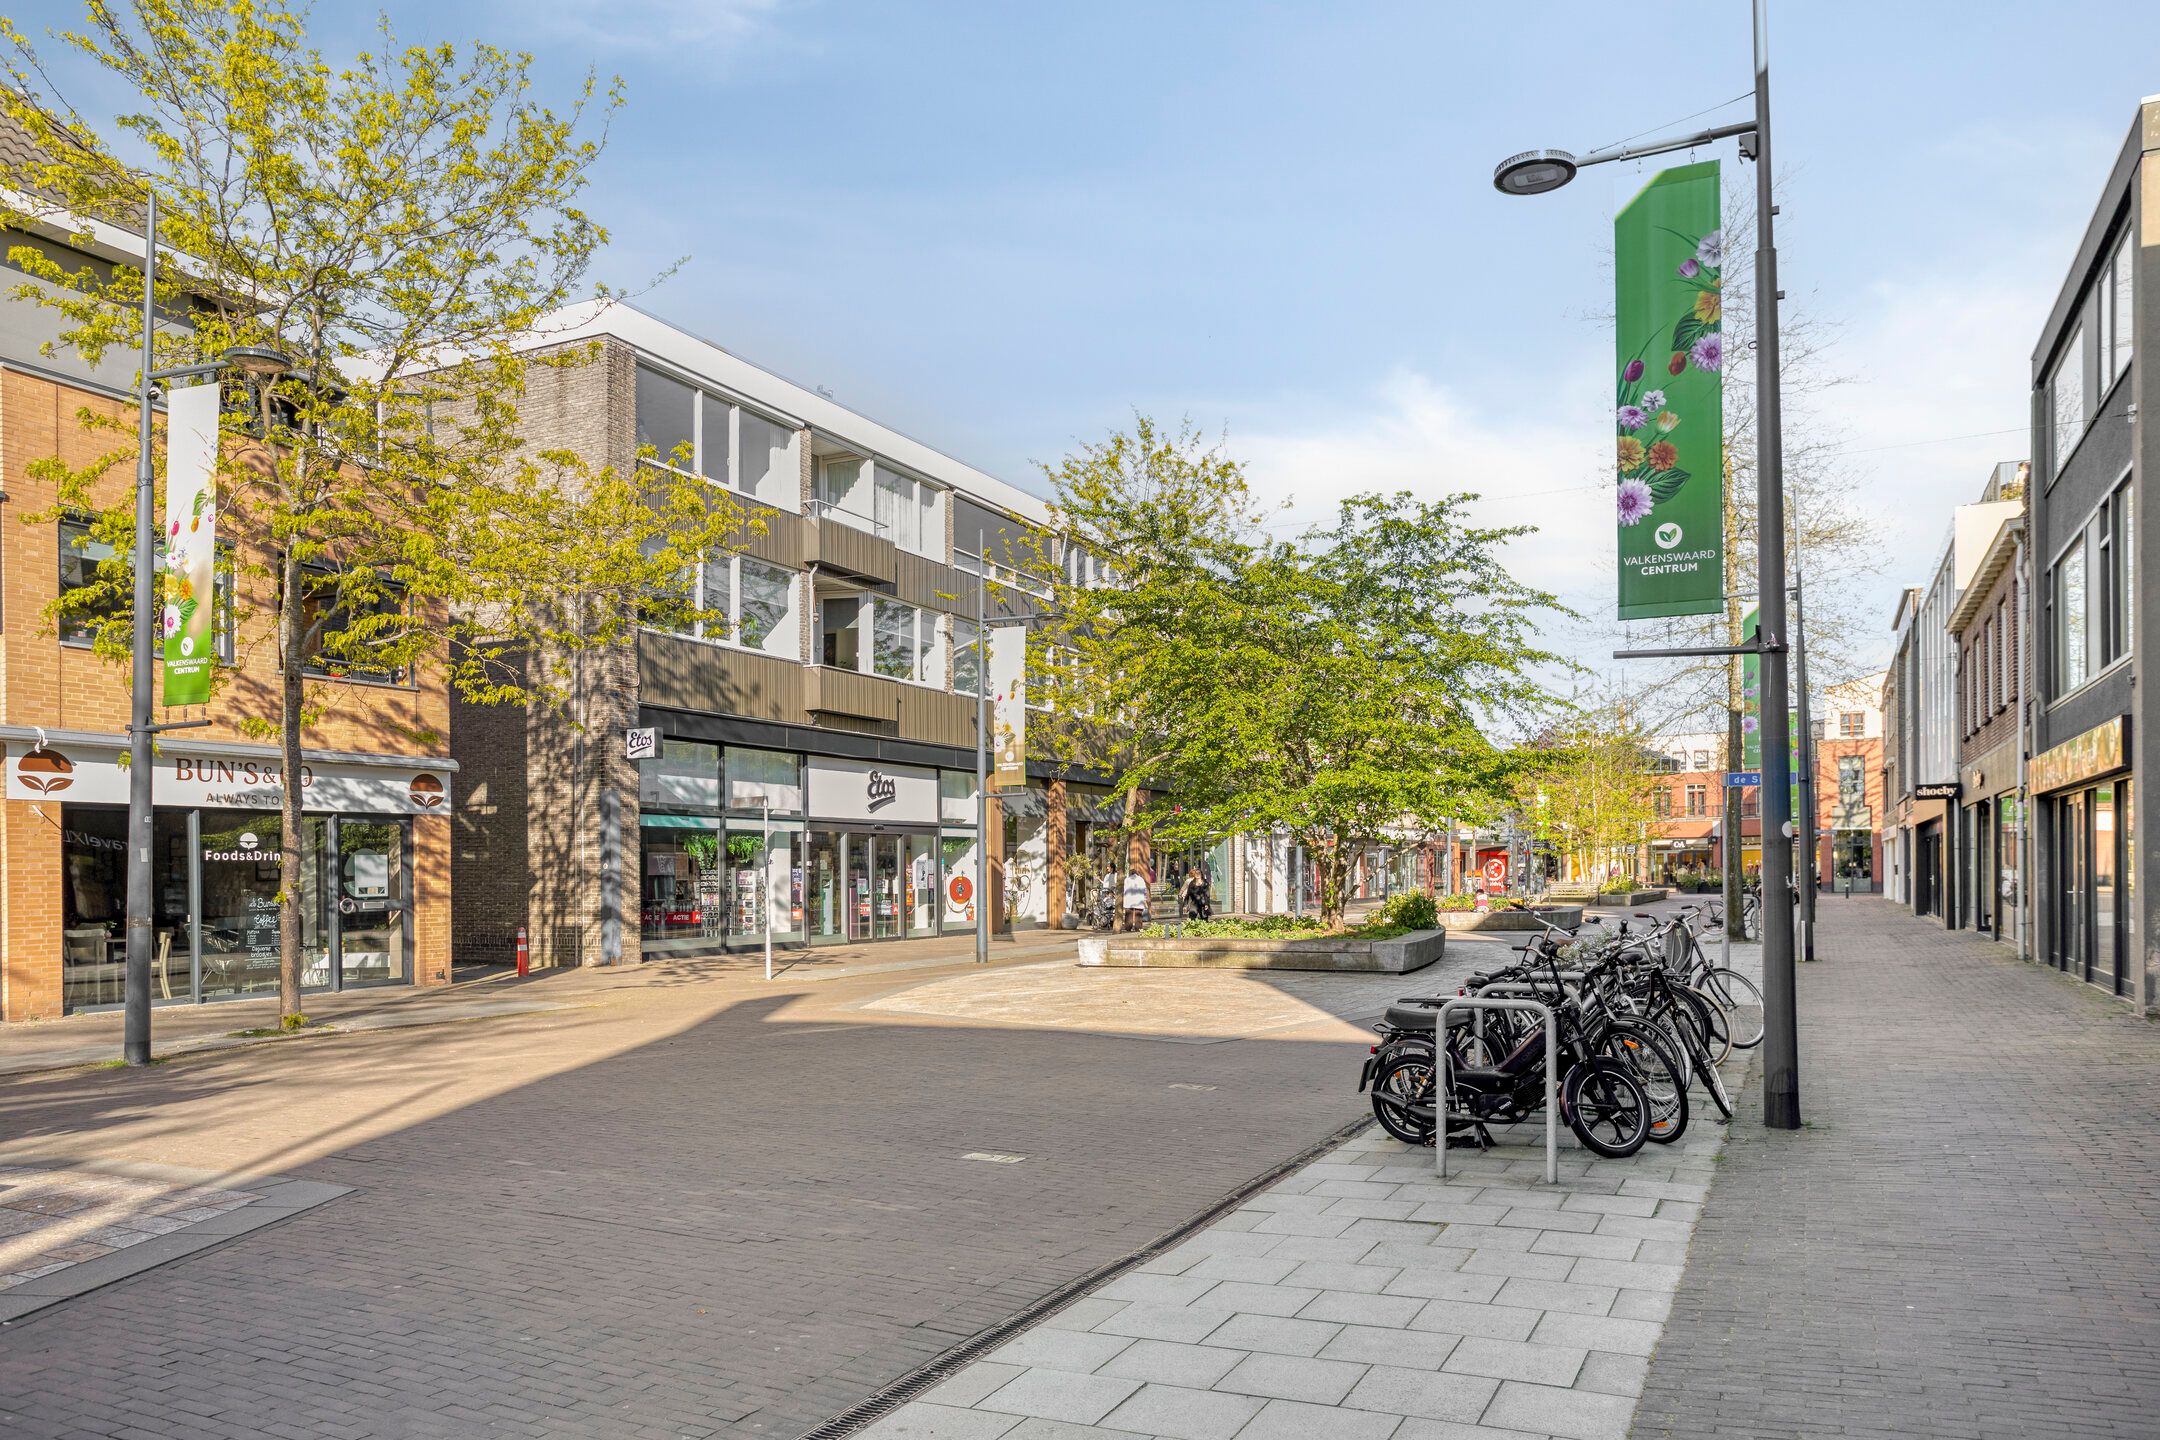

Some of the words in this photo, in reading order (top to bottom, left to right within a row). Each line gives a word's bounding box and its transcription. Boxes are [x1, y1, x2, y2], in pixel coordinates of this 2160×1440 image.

[1623, 549, 1716, 566] VALKENSWAARD
[1640, 562, 1698, 576] CENTRUM
[167, 657, 208, 667] VALKENSWAARD
[174, 666, 200, 675] CENTRUM
[629, 731, 653, 749] Etos
[867, 770, 896, 800] Etos
[1734, 776, 1746, 784] de
[1916, 785, 1957, 797] shoeby
[205, 792, 259, 805] ALWAYS
[263, 795, 280, 806] TO
[205, 850, 283, 861] Foods&Drin
